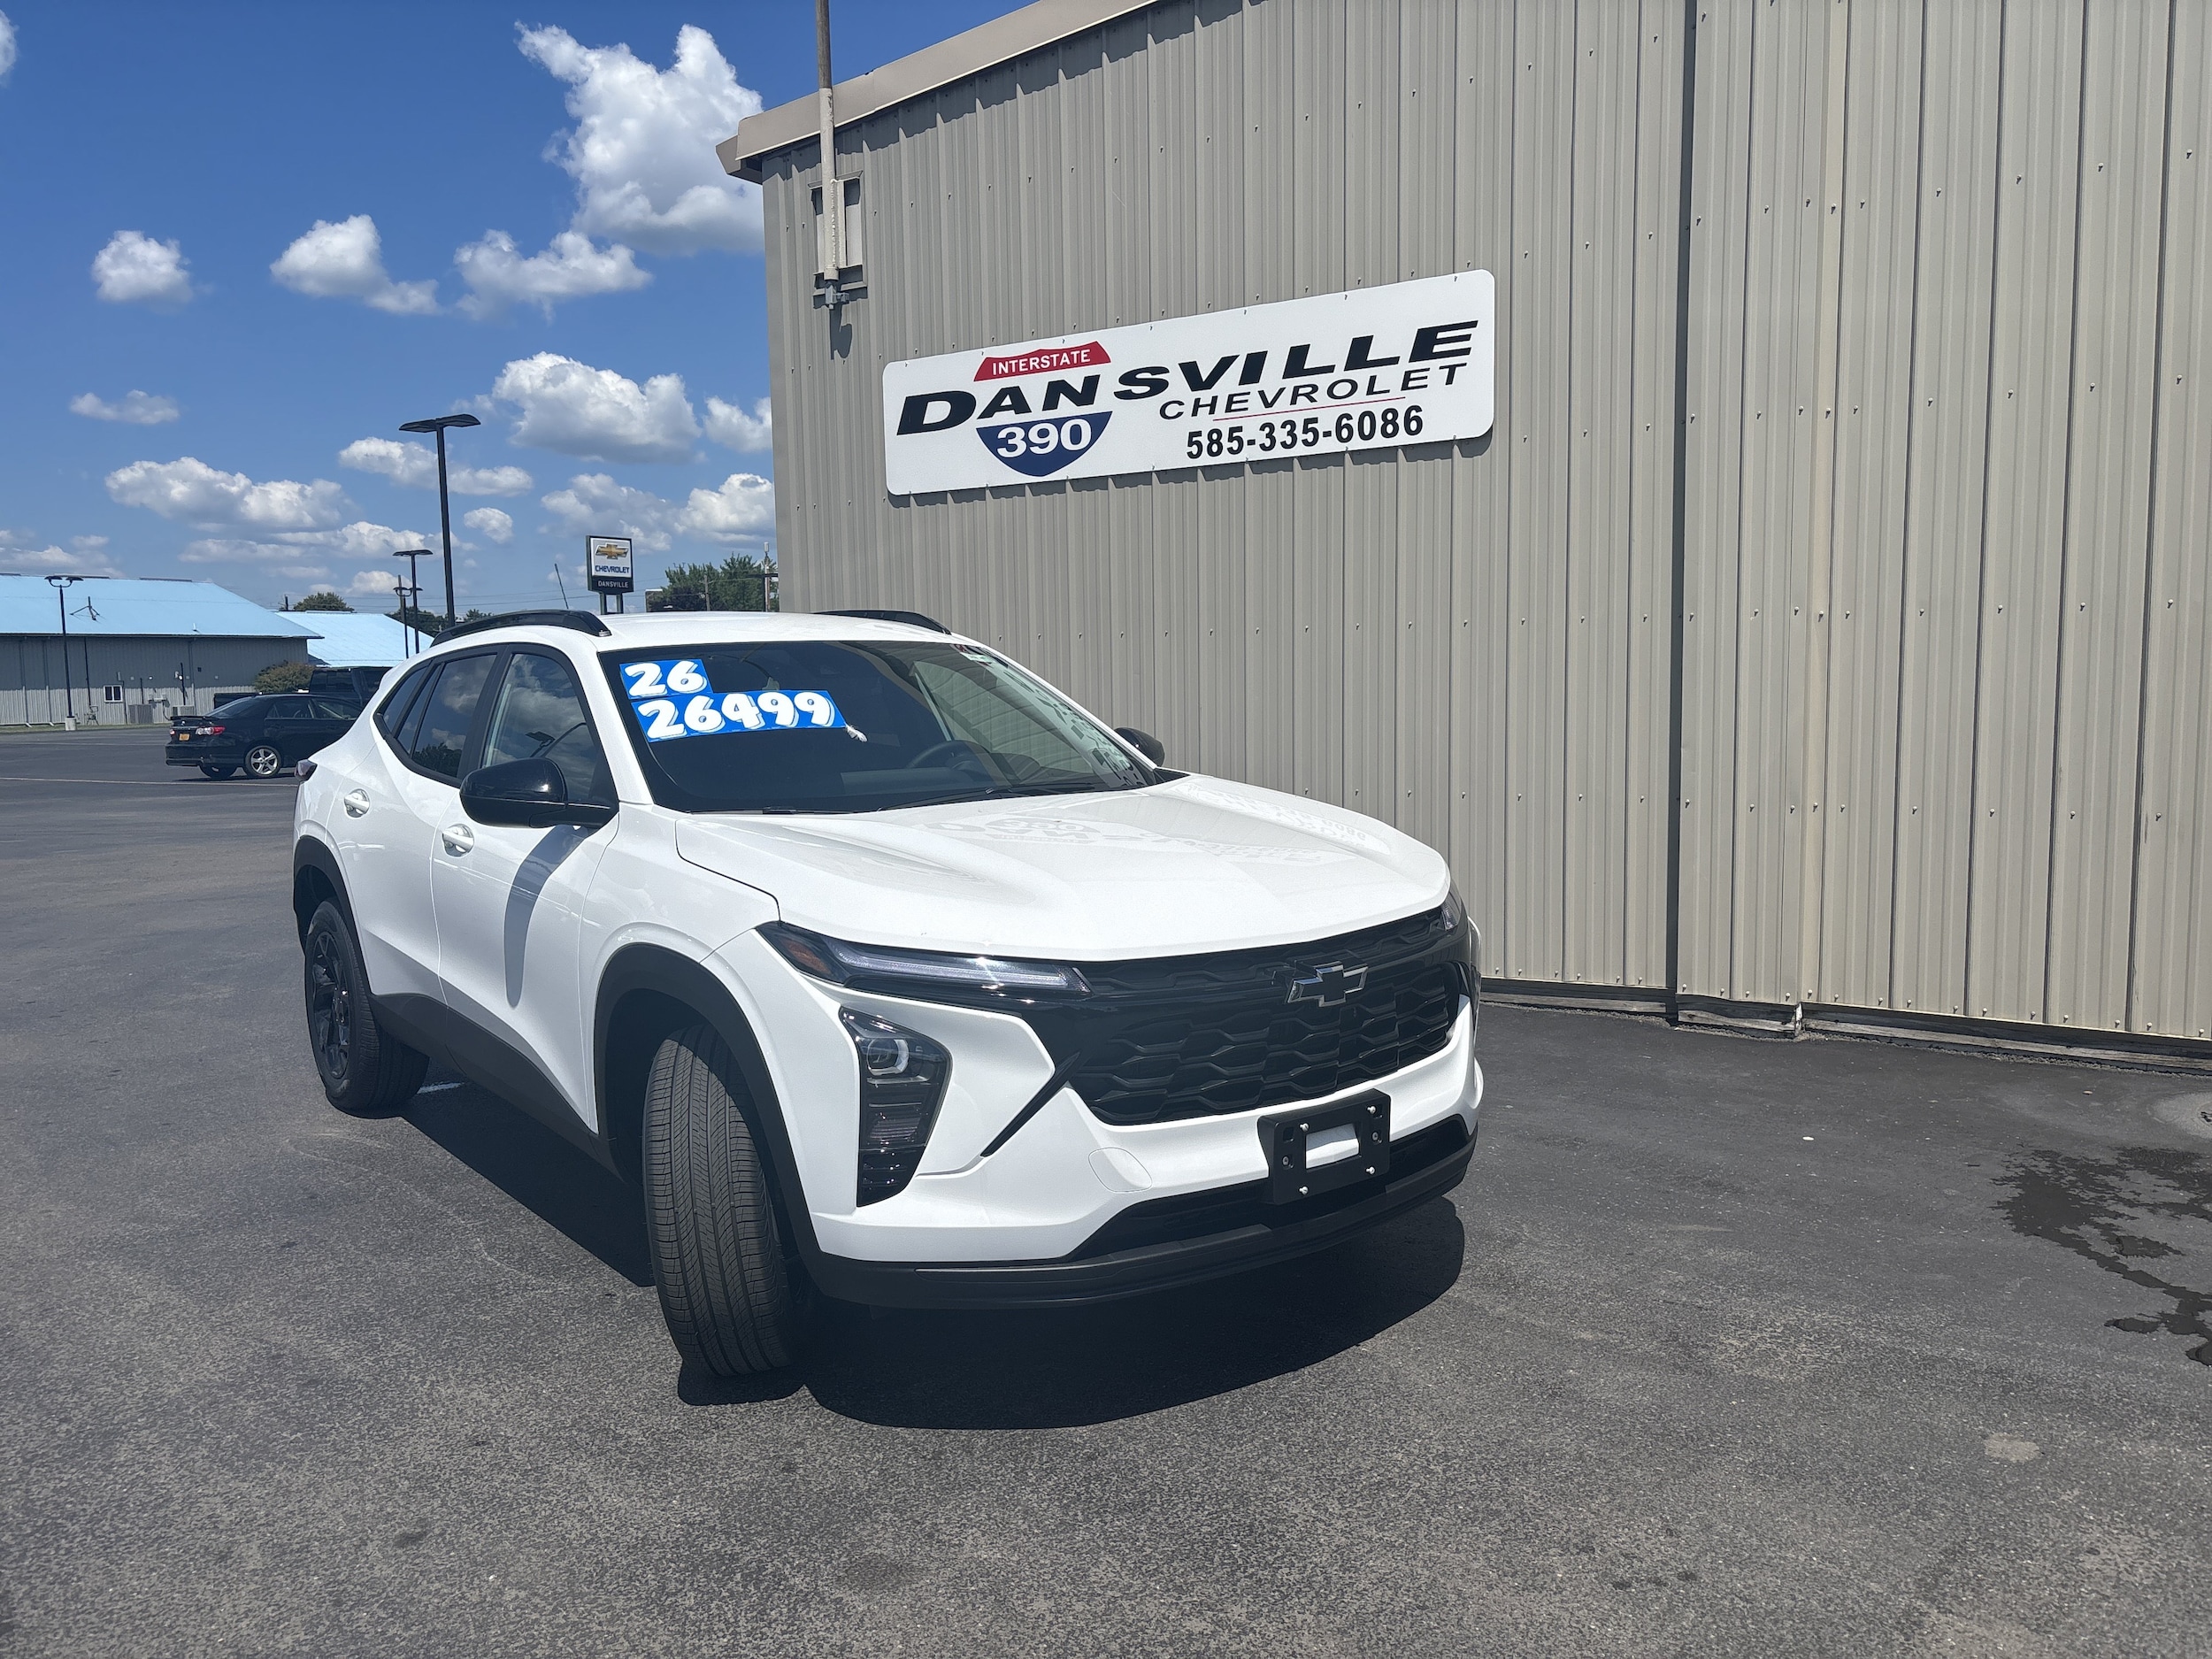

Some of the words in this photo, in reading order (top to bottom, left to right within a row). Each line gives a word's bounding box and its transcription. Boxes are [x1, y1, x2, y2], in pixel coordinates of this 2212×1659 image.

[992, 349, 1091, 376] INTERSTATE
[1159, 362, 1468, 420] CHEVROLET
[996, 418, 1092, 458] 390
[1186, 404, 1424, 460] 585-335-6086
[595, 565, 630, 574] CHEVROLET
[624, 660, 708, 698] 26
[637, 691, 835, 740] 26499
